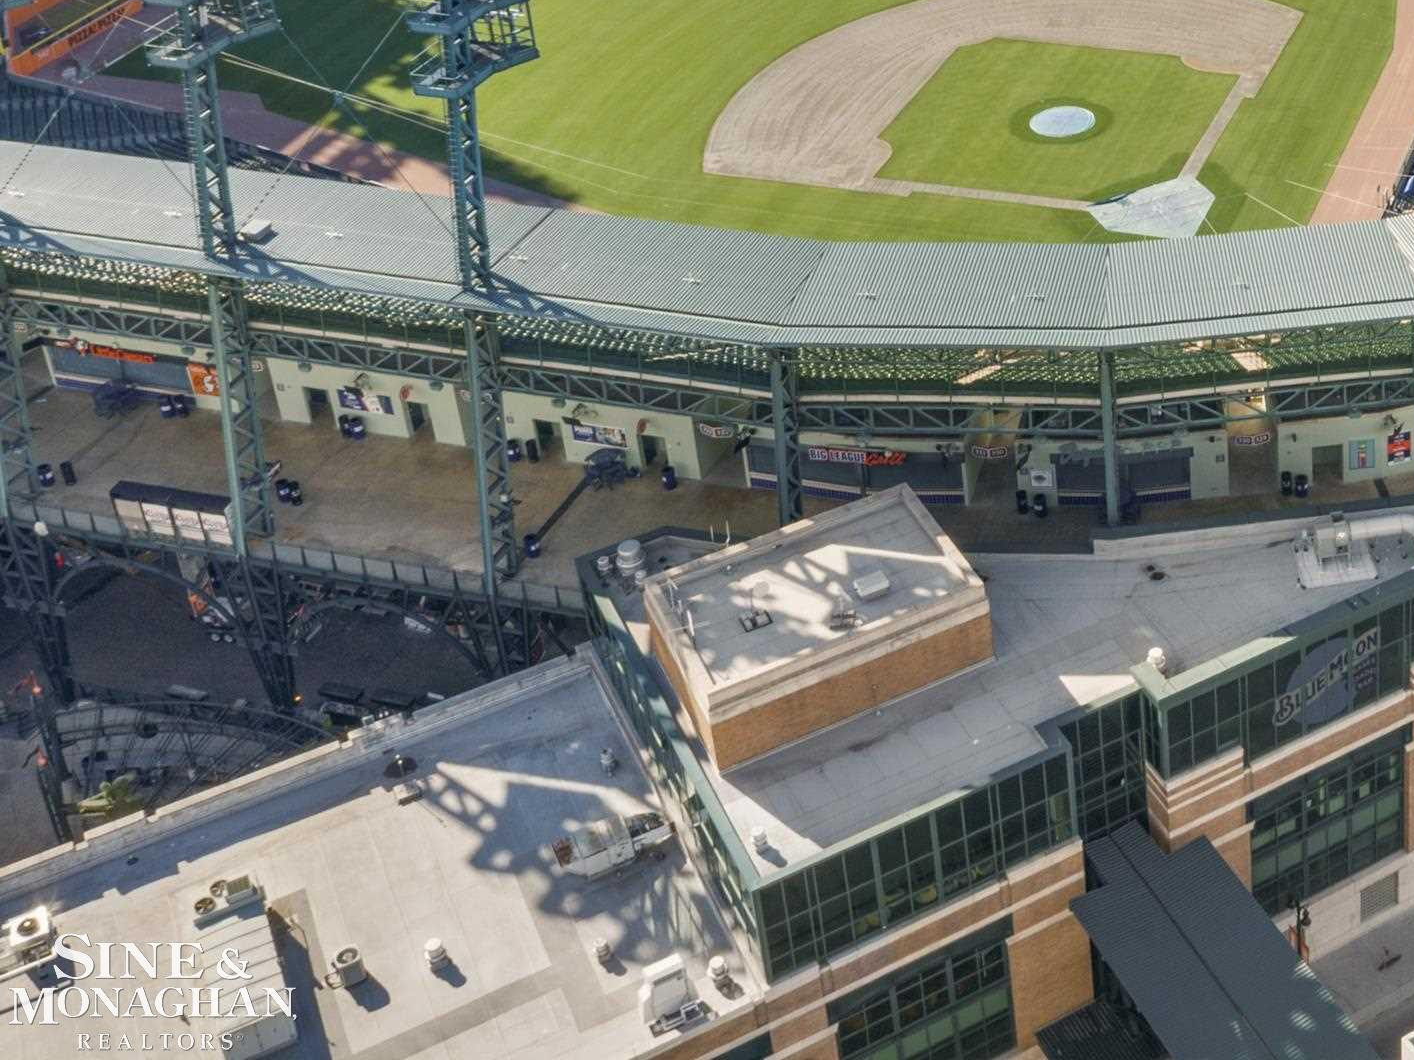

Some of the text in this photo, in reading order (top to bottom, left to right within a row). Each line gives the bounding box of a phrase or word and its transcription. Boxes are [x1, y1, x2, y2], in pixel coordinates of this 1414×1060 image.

[808, 448, 828, 461] BIG
[829, 449, 866, 463] LEAGUE
[1273, 674, 1328, 727] BLUE
